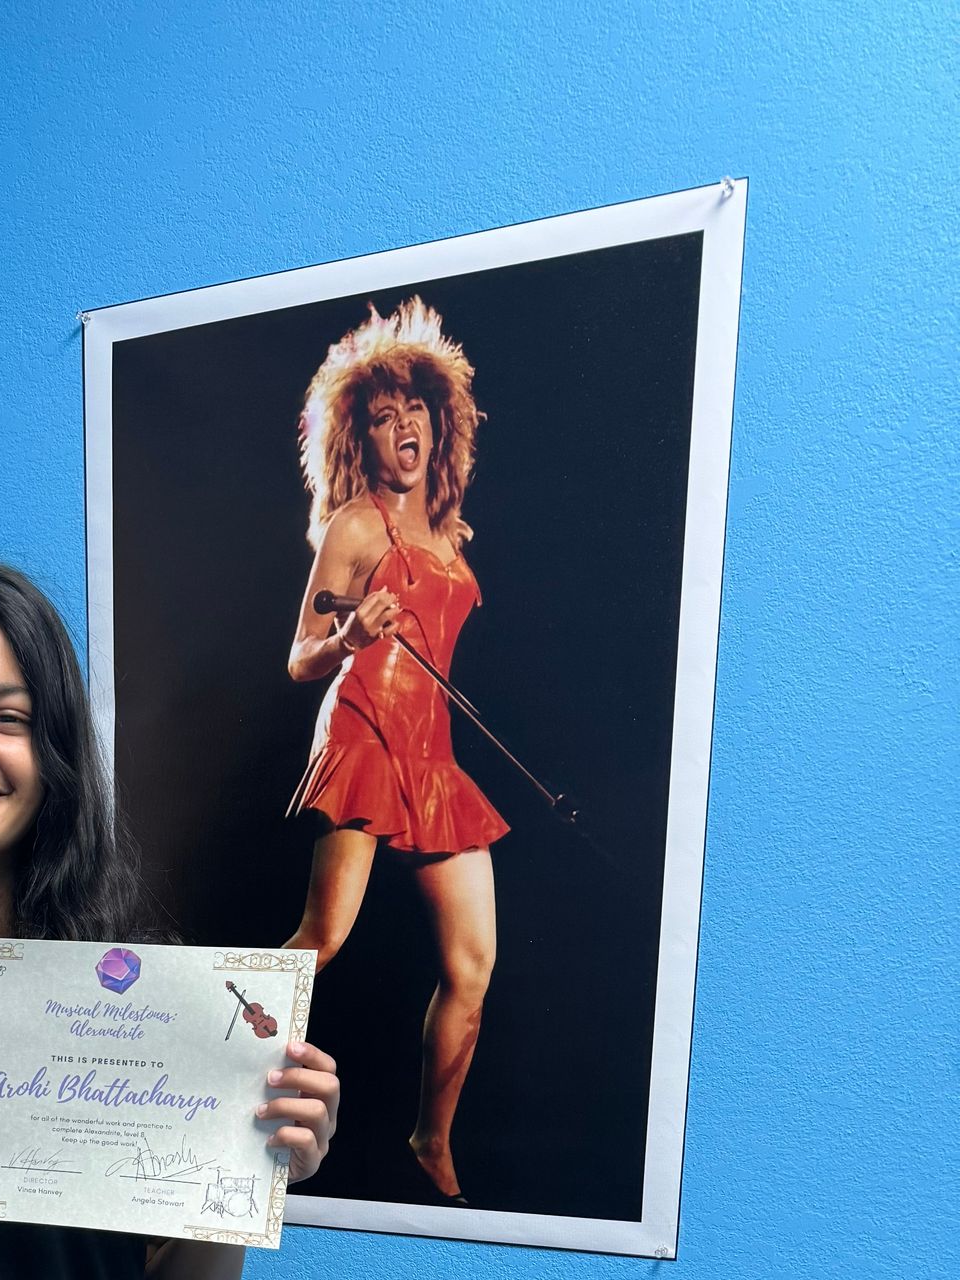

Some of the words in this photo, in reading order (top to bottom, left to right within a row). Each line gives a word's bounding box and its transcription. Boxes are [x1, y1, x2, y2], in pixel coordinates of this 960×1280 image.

[45, 999, 101, 1019] Musical
[103, 1002, 178, 1024] Milestones:
[70, 1019, 145, 1040] Alexandrite
[51, 1055, 74, 1063] THIS
[78, 1056, 87, 1064] IS
[91, 1057, 147, 1067] PRESENTED
[151, 1061, 164, 1069] TO
[56, 1069, 221, 1122] Bhattacharya
[71, 1117, 104, 1125] wonderful
[123, 1120, 135, 1128] and
[136, 1121, 164, 1130] practice
[52, 1126, 83, 1135] complete
[124, 1130, 139, 1138] level
[61, 1136, 78, 1145] Keep
[101, 1139, 119, 1147] good
[23, 1177, 58, 1186] DIRECTOR
[17, 1186, 37, 1194] Vince
[38, 1188, 63, 1197] Hanvey
[143, 1186, 176, 1196] TEACHER
[131, 1196, 156, 1206] Angela
